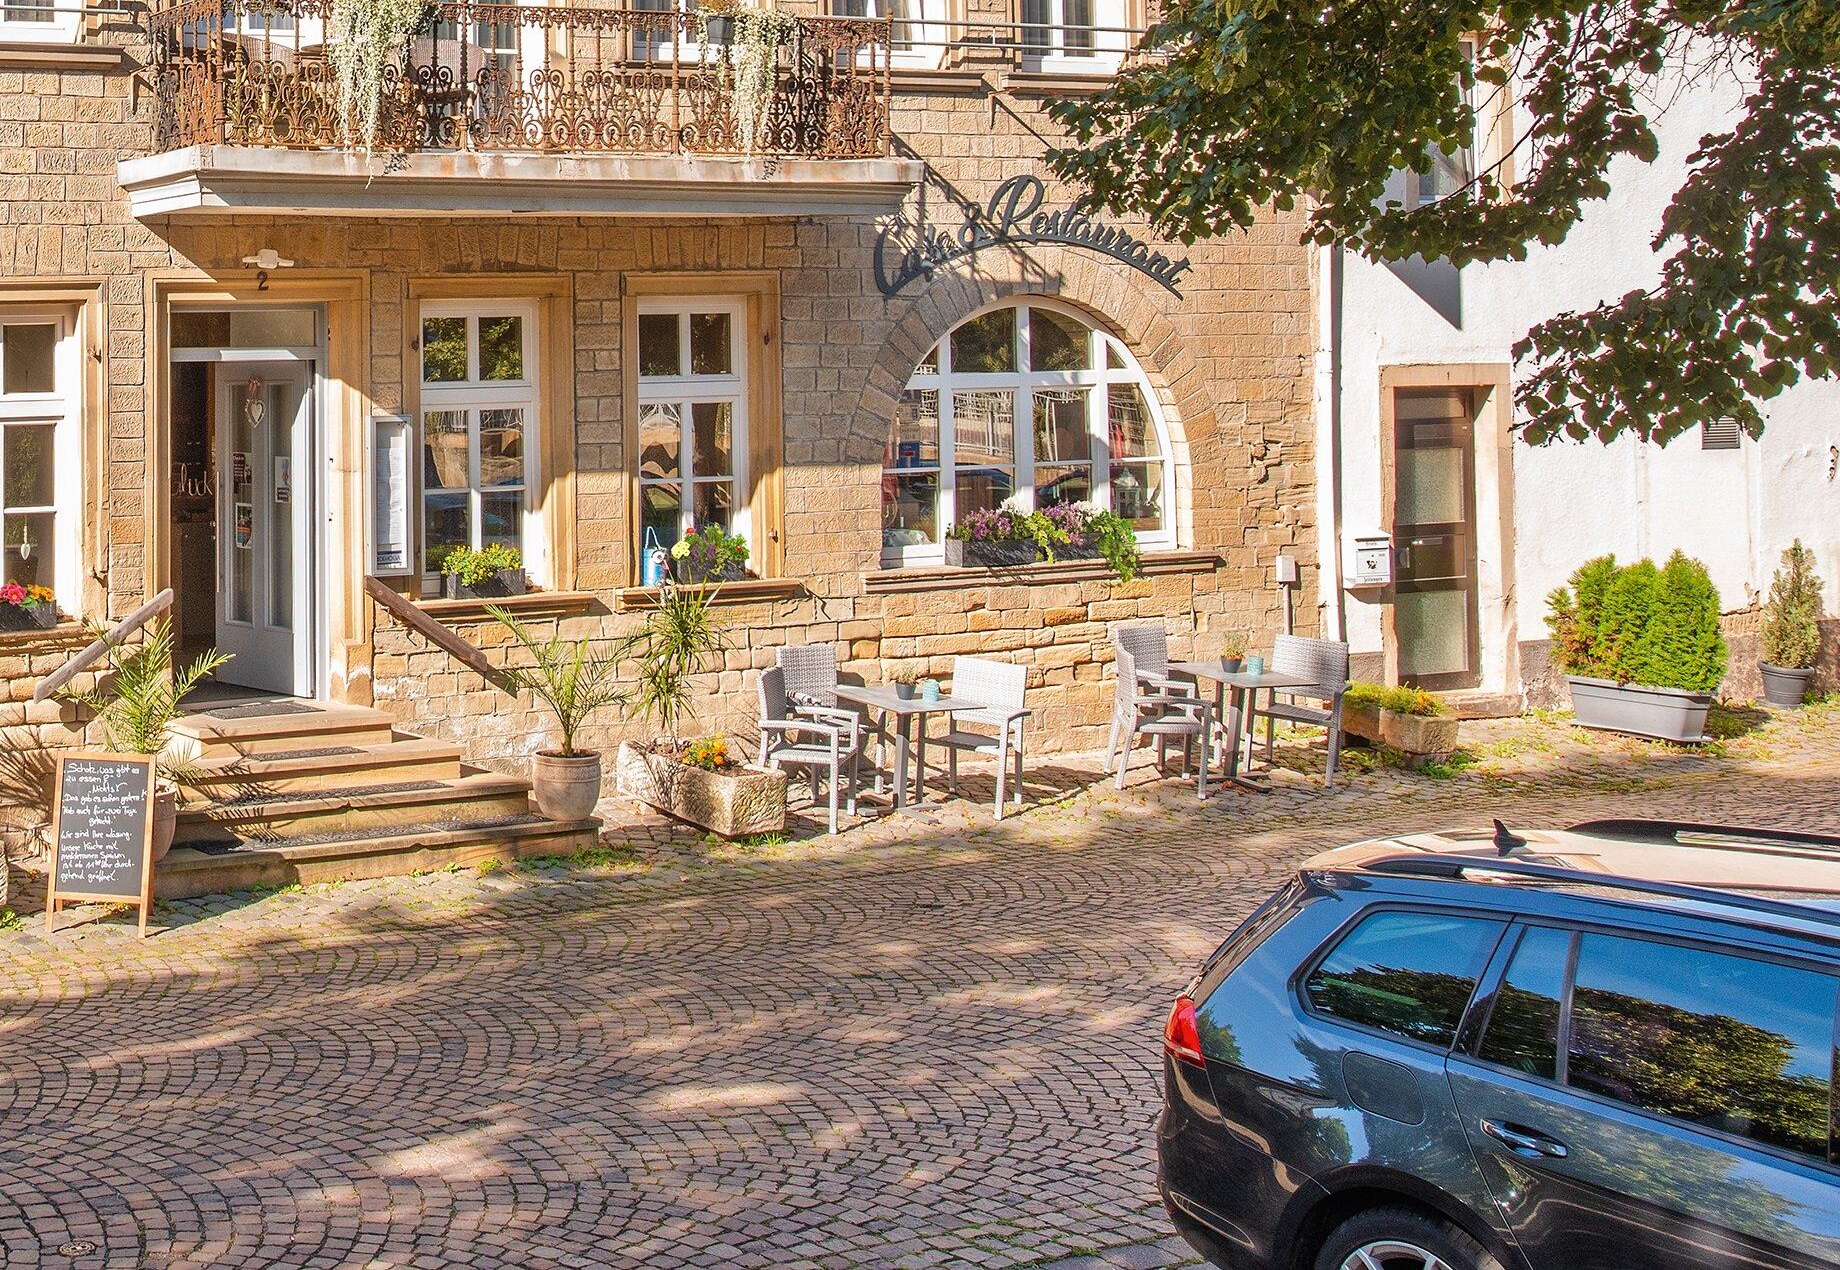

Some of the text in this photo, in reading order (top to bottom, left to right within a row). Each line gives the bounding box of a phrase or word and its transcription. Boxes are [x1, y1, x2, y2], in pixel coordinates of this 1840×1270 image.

[987, 174, 1194, 301] Restaurant
[256, 270, 270, 291] 2
[74, 829, 89, 838] sind
